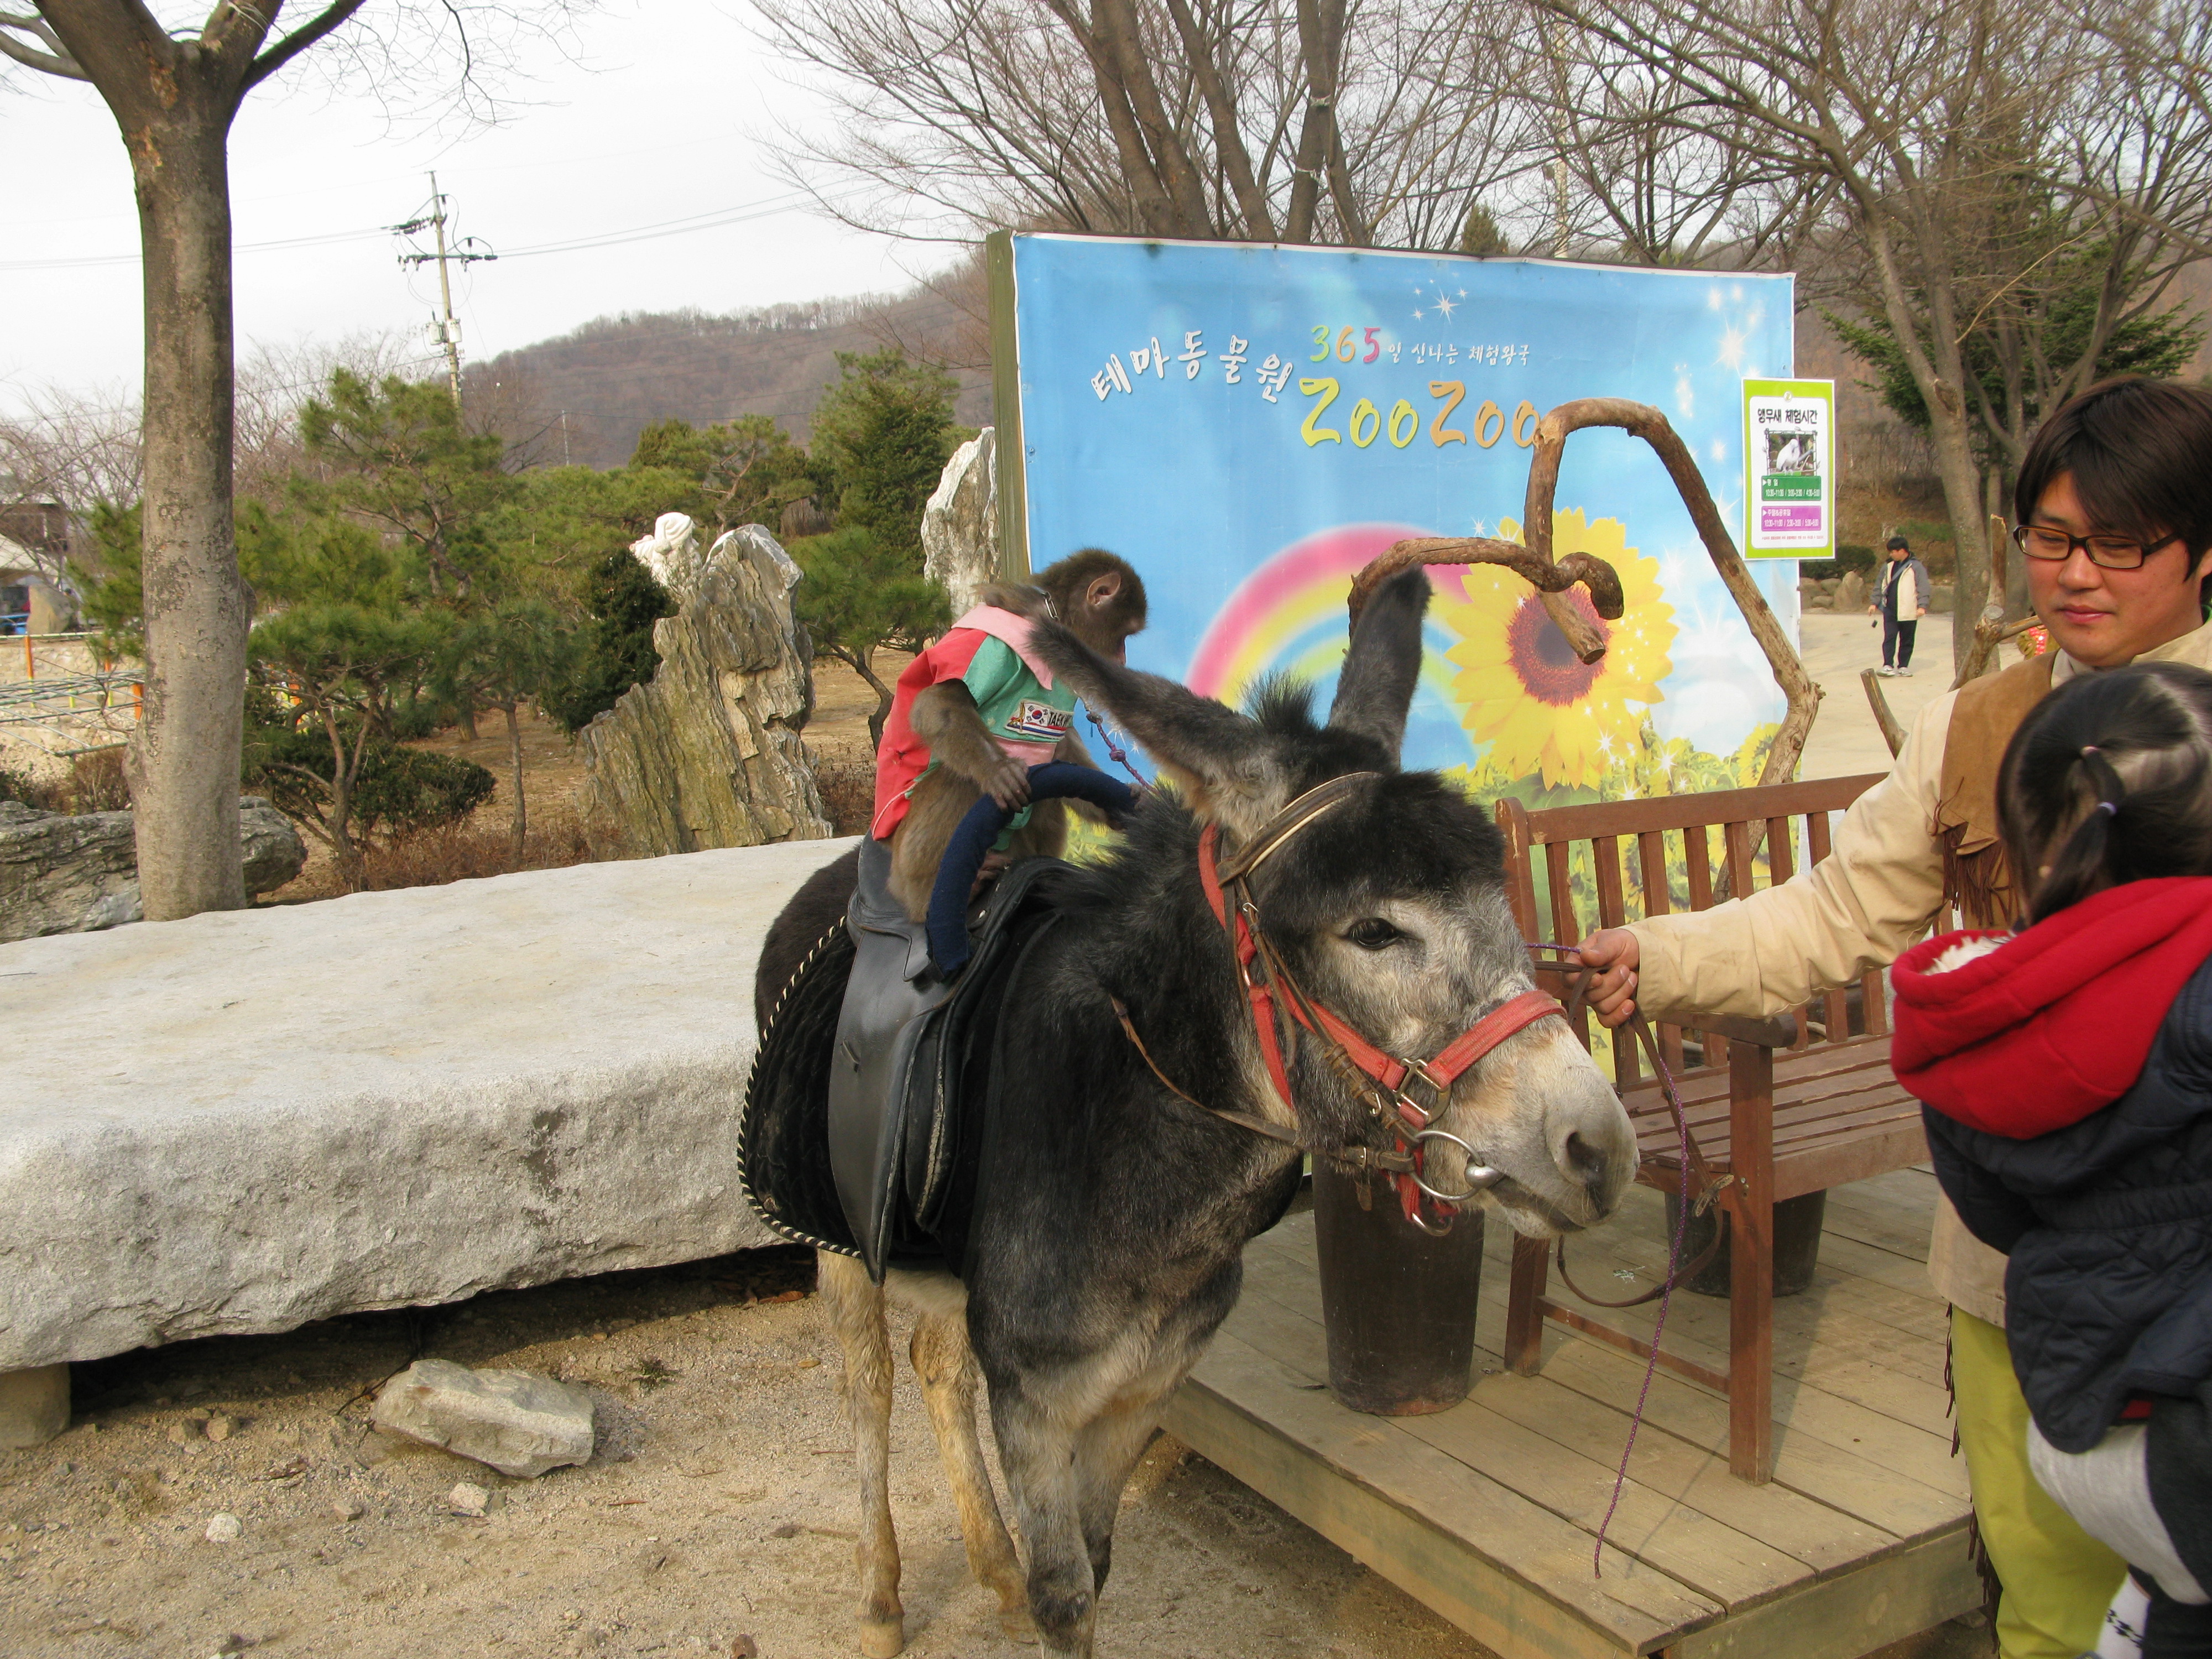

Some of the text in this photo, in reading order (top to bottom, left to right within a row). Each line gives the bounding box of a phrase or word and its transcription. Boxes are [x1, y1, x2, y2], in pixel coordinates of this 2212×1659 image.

[1091, 330, 1293, 403] 테마동물원
[1411, 343, 1459, 366] 신나는
[1468, 343, 1531, 367] 체험왕국
[1757, 408, 1818, 424] 앵무새 체험시간
